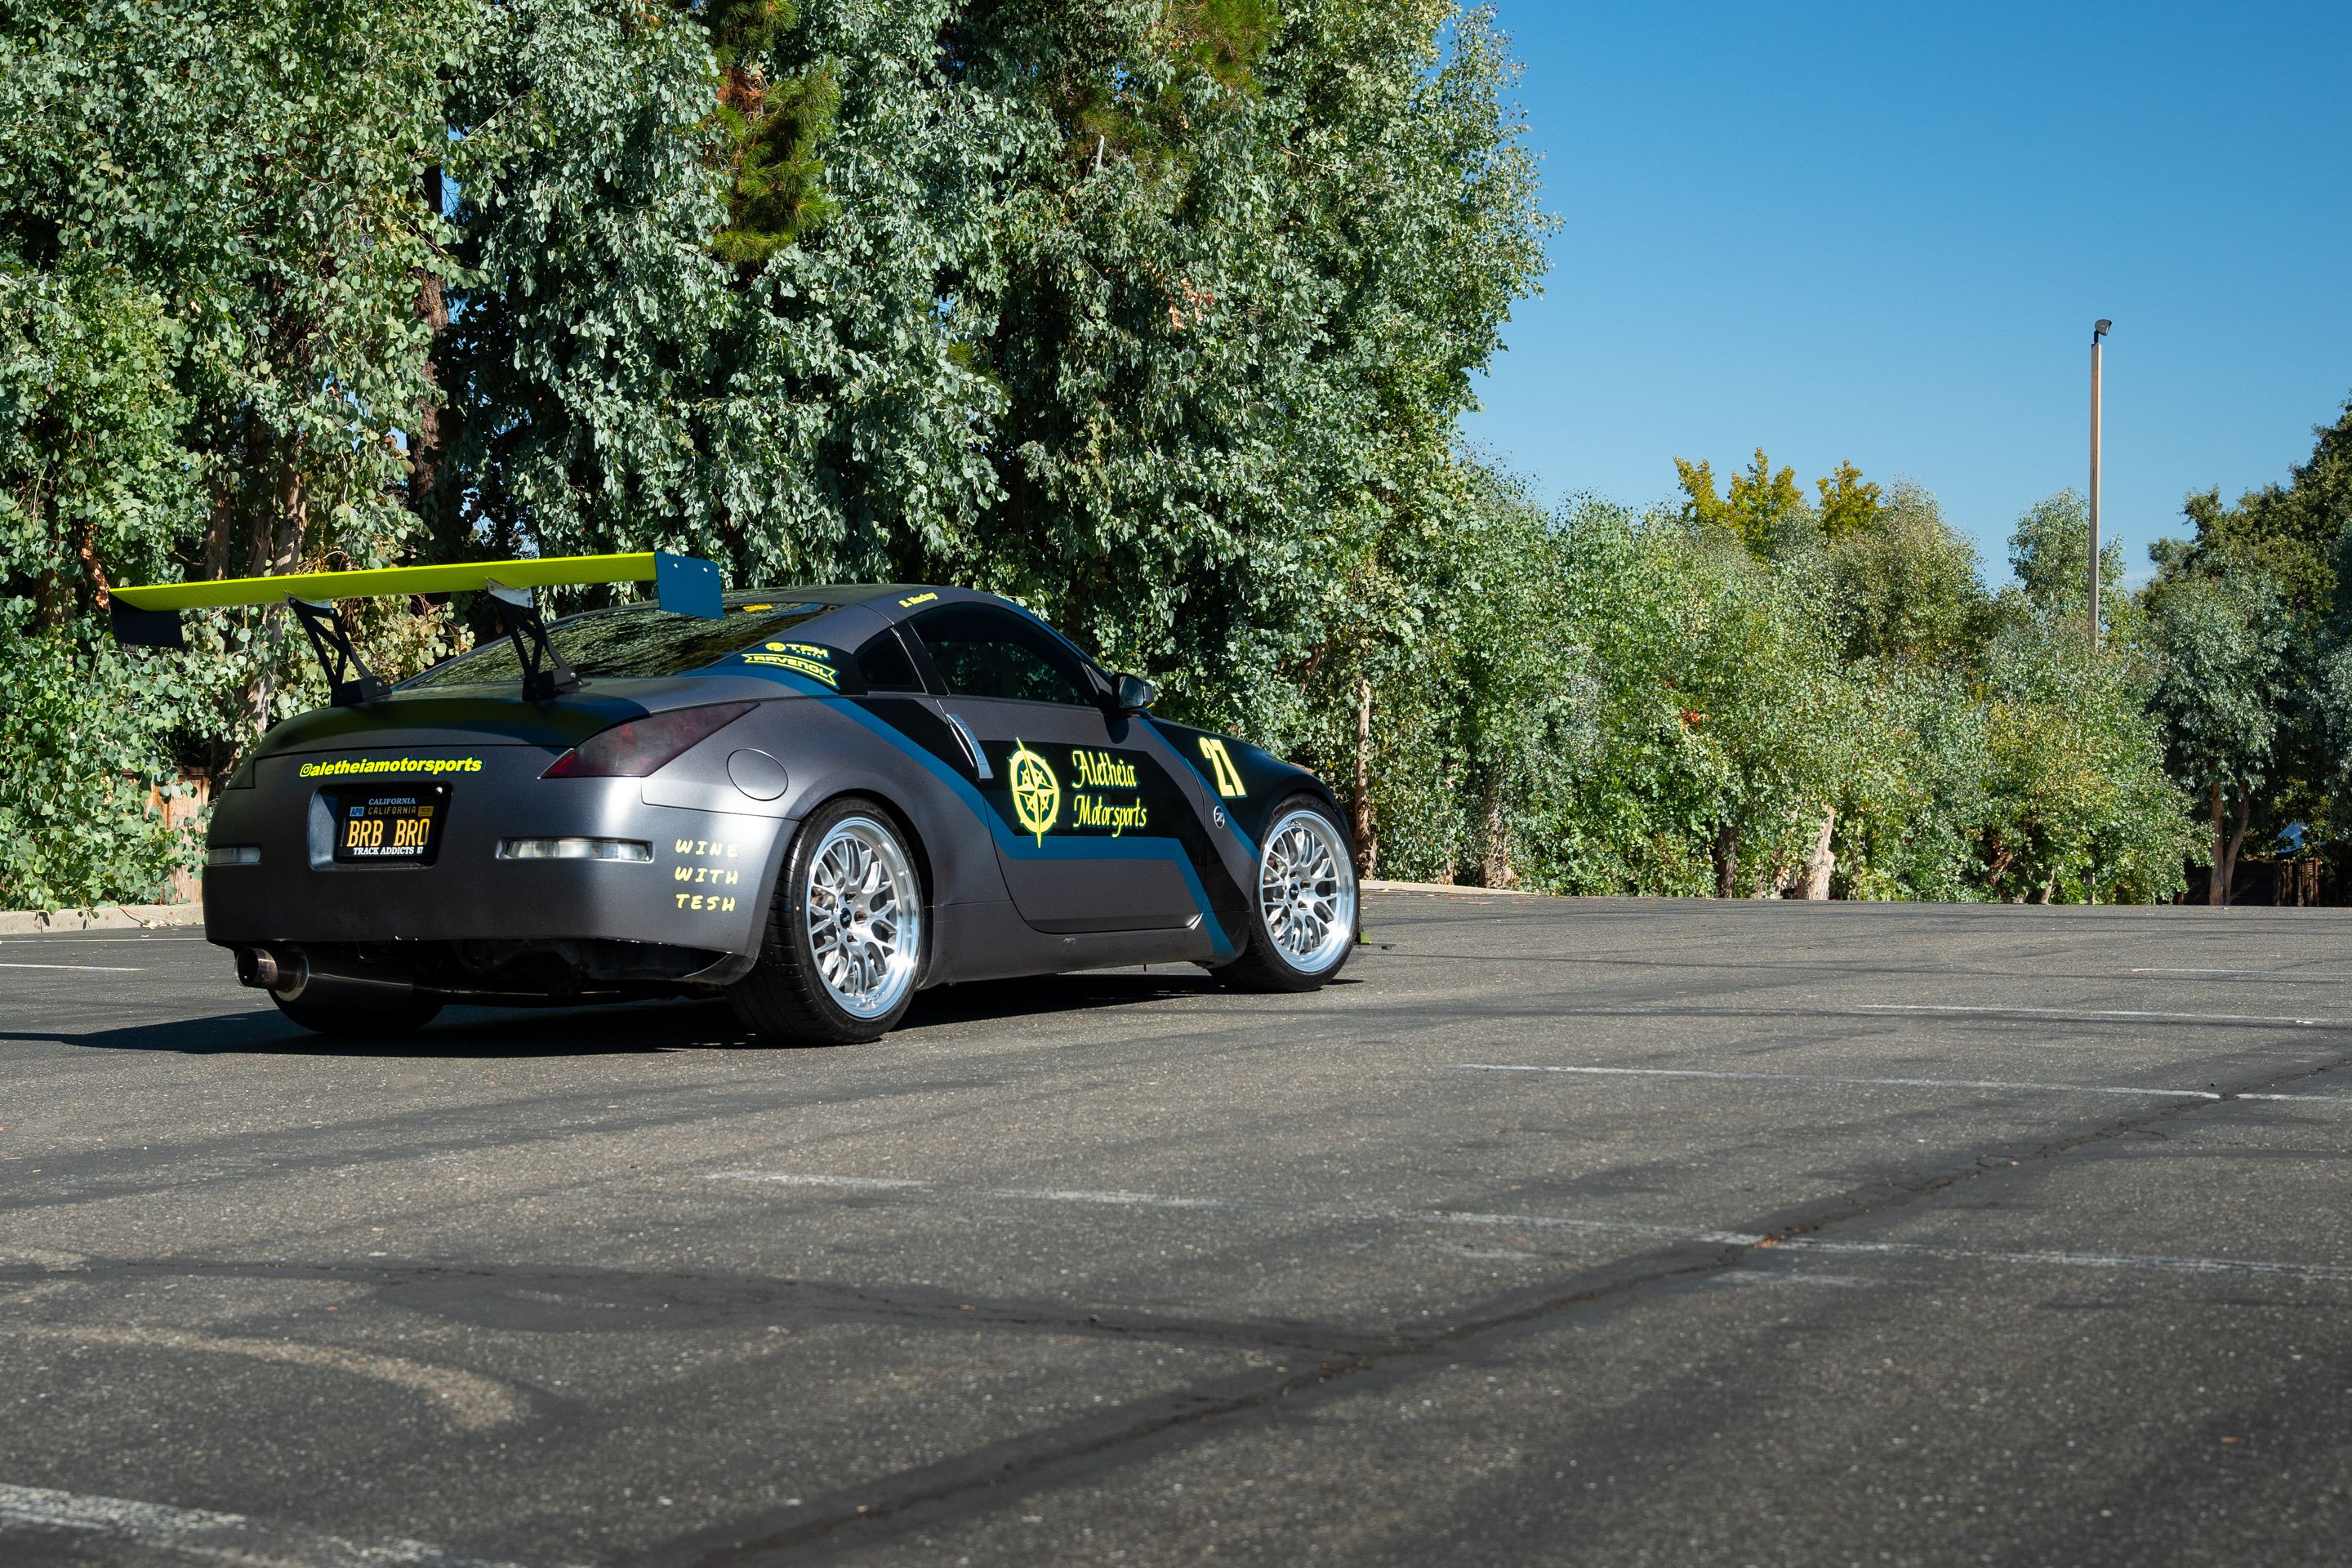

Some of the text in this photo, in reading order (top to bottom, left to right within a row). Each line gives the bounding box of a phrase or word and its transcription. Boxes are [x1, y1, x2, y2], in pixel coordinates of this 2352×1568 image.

[786, 644, 829, 658] TPM
[1071, 750, 1138, 789] Aletheia
[368, 797, 416, 805] CALIFORNIA
[350, 807, 363, 815] APR
[368, 806, 416, 815] CALIFORNIA
[1072, 795, 1147, 838] Motorsports
[346, 818, 430, 847] BRB BRO
[353, 846, 415, 855] TRACK ADDICTS
[675, 839, 739, 858] WINE
[675, 866, 739, 884] WITH
[675, 893, 736, 912] TESH
